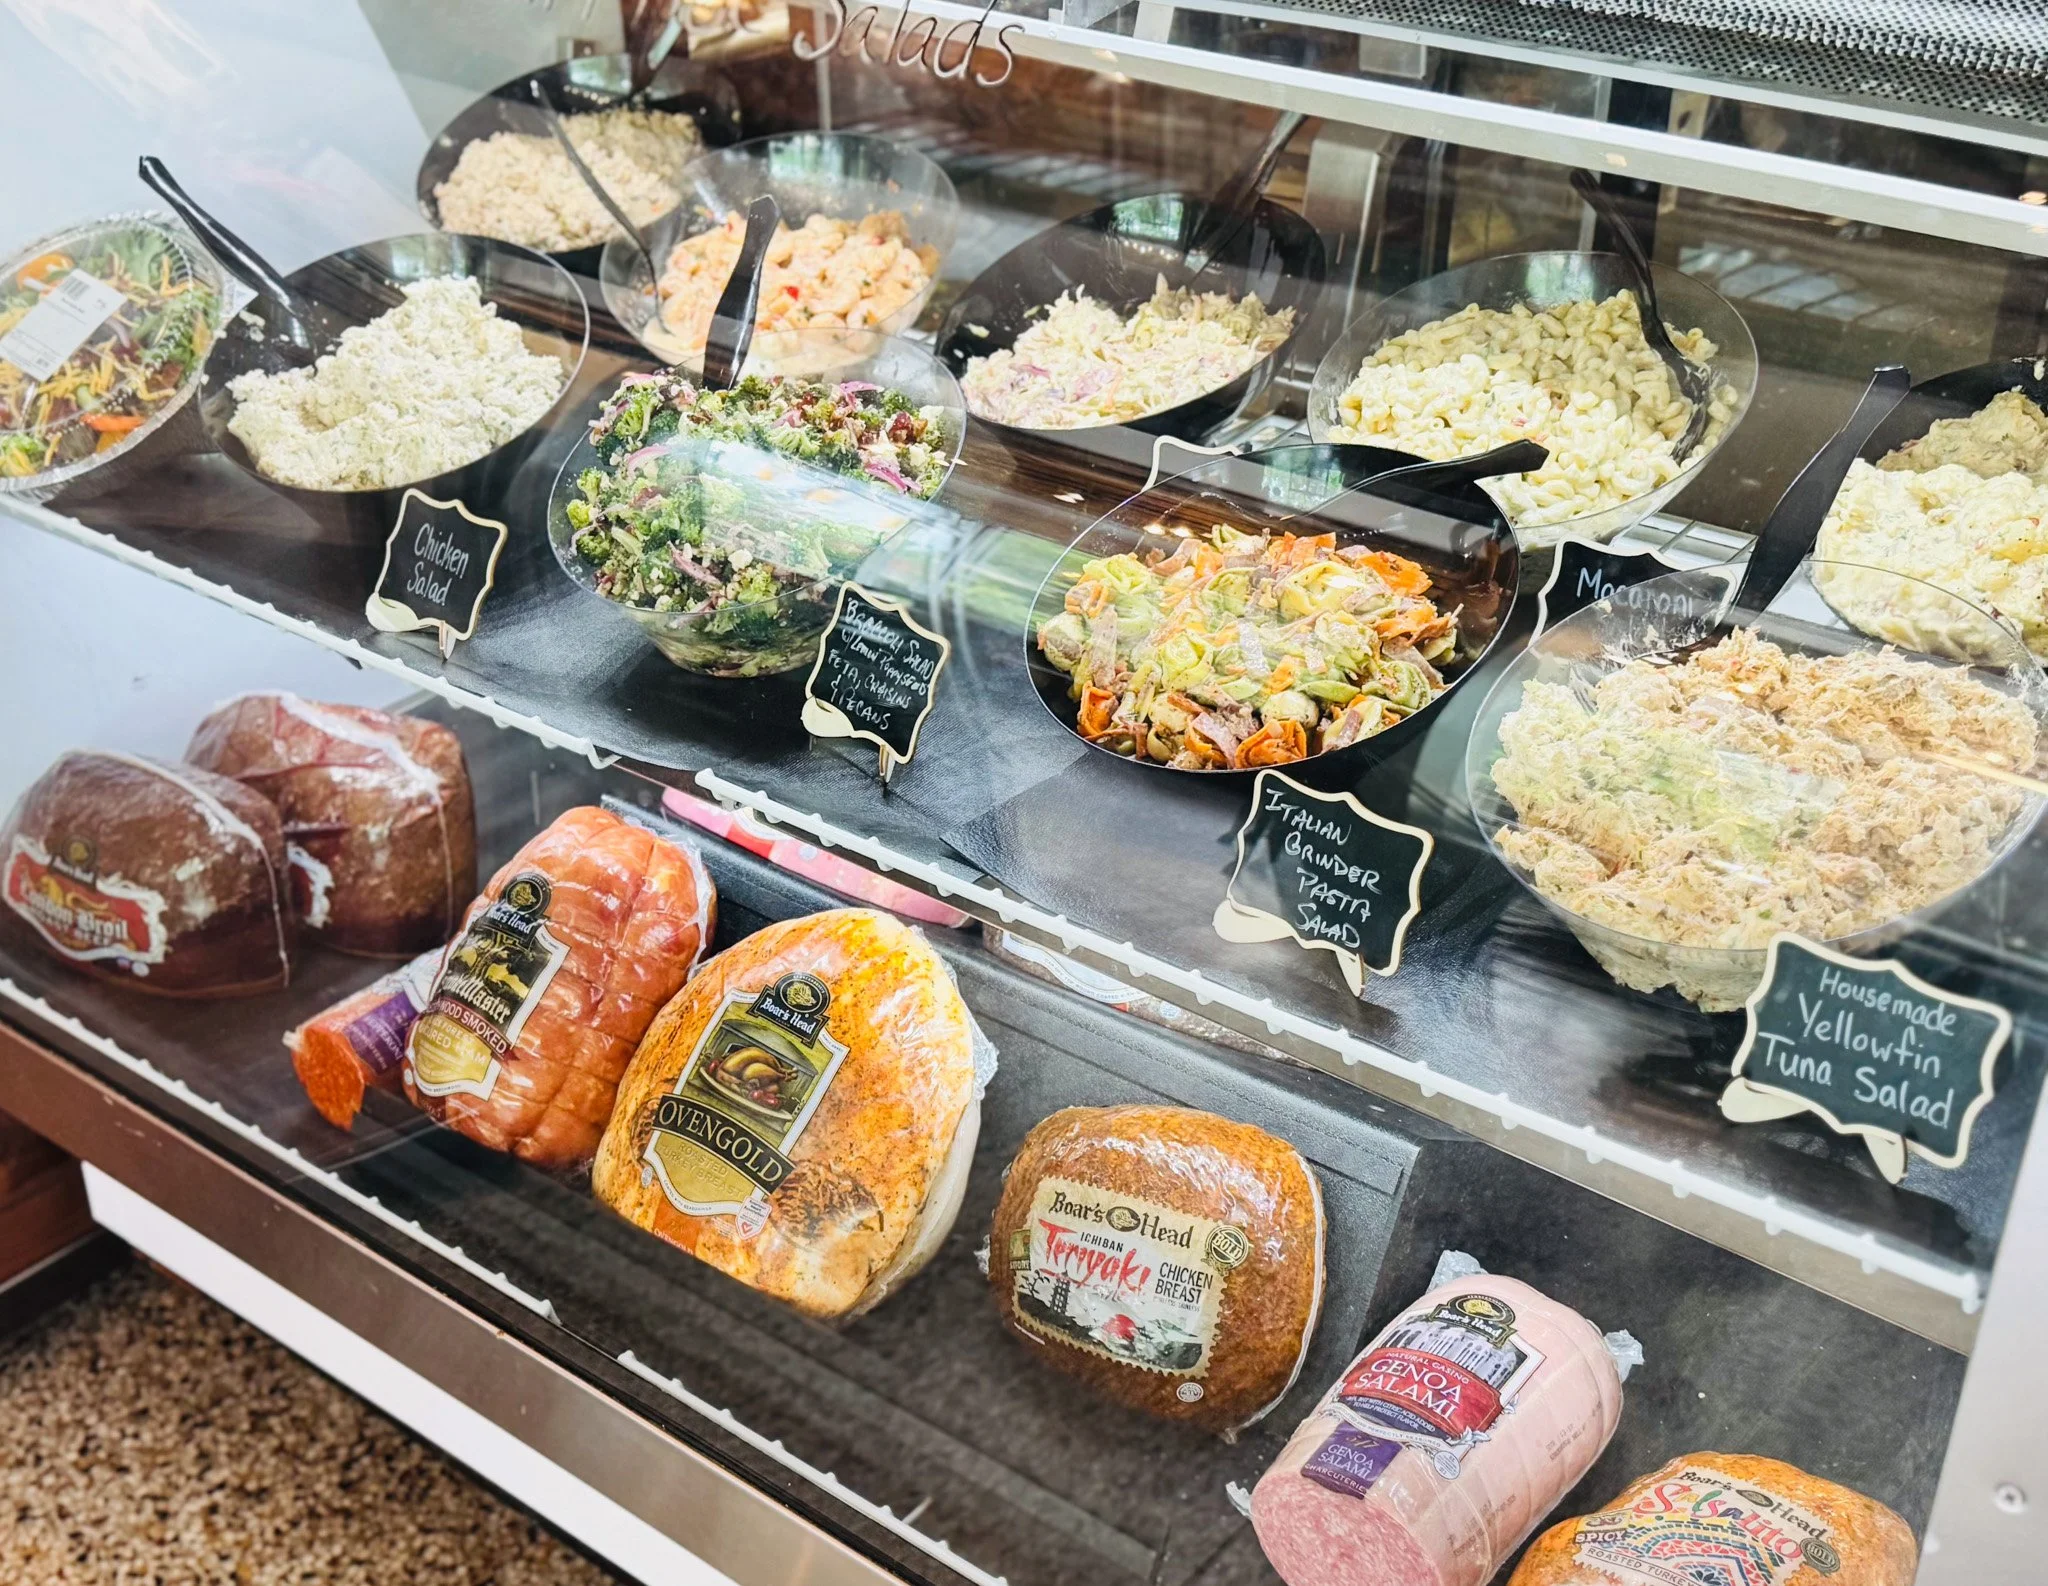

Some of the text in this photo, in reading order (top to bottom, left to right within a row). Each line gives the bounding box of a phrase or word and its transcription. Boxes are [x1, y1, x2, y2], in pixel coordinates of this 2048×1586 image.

[414, 523, 470, 579] Chicken
[406, 561, 452, 606] Salad
[839, 686, 891, 730] PECANS
[1264, 788, 1351, 846] ITALIAN
[1284, 831, 1382, 895] GRINDER
[1296, 867, 1371, 923] PASTA
[509, 914, 533, 935] Head
[1295, 902, 1361, 949] SALAD
[760, 997, 817, 1035] Boar's Head
[1819, 966, 1957, 1037] Housemade
[461, 1011, 507, 1054] SMOKED
[1798, 992, 1940, 1079] Yellowfin
[1758, 1031, 1954, 1130] Tuna Salad
[659, 1100, 783, 1182] OVENGOLD
[1048, 1190, 1194, 1250] Boar's Head
[1080, 1231, 1124, 1253] ICHIBAN
[1213, 1232, 1243, 1260] BOLD
[1154, 1278, 1203, 1305] BREAST
[1159, 1262, 1213, 1290] CHICKEN
[1471, 1317, 1503, 1337] Head
[1371, 1358, 1461, 1404] GENOA
[1386, 1352, 1470, 1384] NATURAL CASING
[1354, 1372, 1459, 1421] SALAMI
[1374, 1405, 1397, 1418] PROTECT
[1382, 1400, 1402, 1413] CITRIC
[1401, 1407, 1417, 1420] ACID
[1414, 1415, 1436, 1432] ADDED
[1304, 1463, 1366, 1493] CHARCUTERIE
[1318, 1452, 1371, 1478] SALAMI
[1327, 1443, 1374, 1470] GENOA
[1679, 1471, 1828, 1540] Boar's Head
[1575, 1530, 1627, 1543] SPICY
[1588, 1548, 1642, 1569] ROASTED
